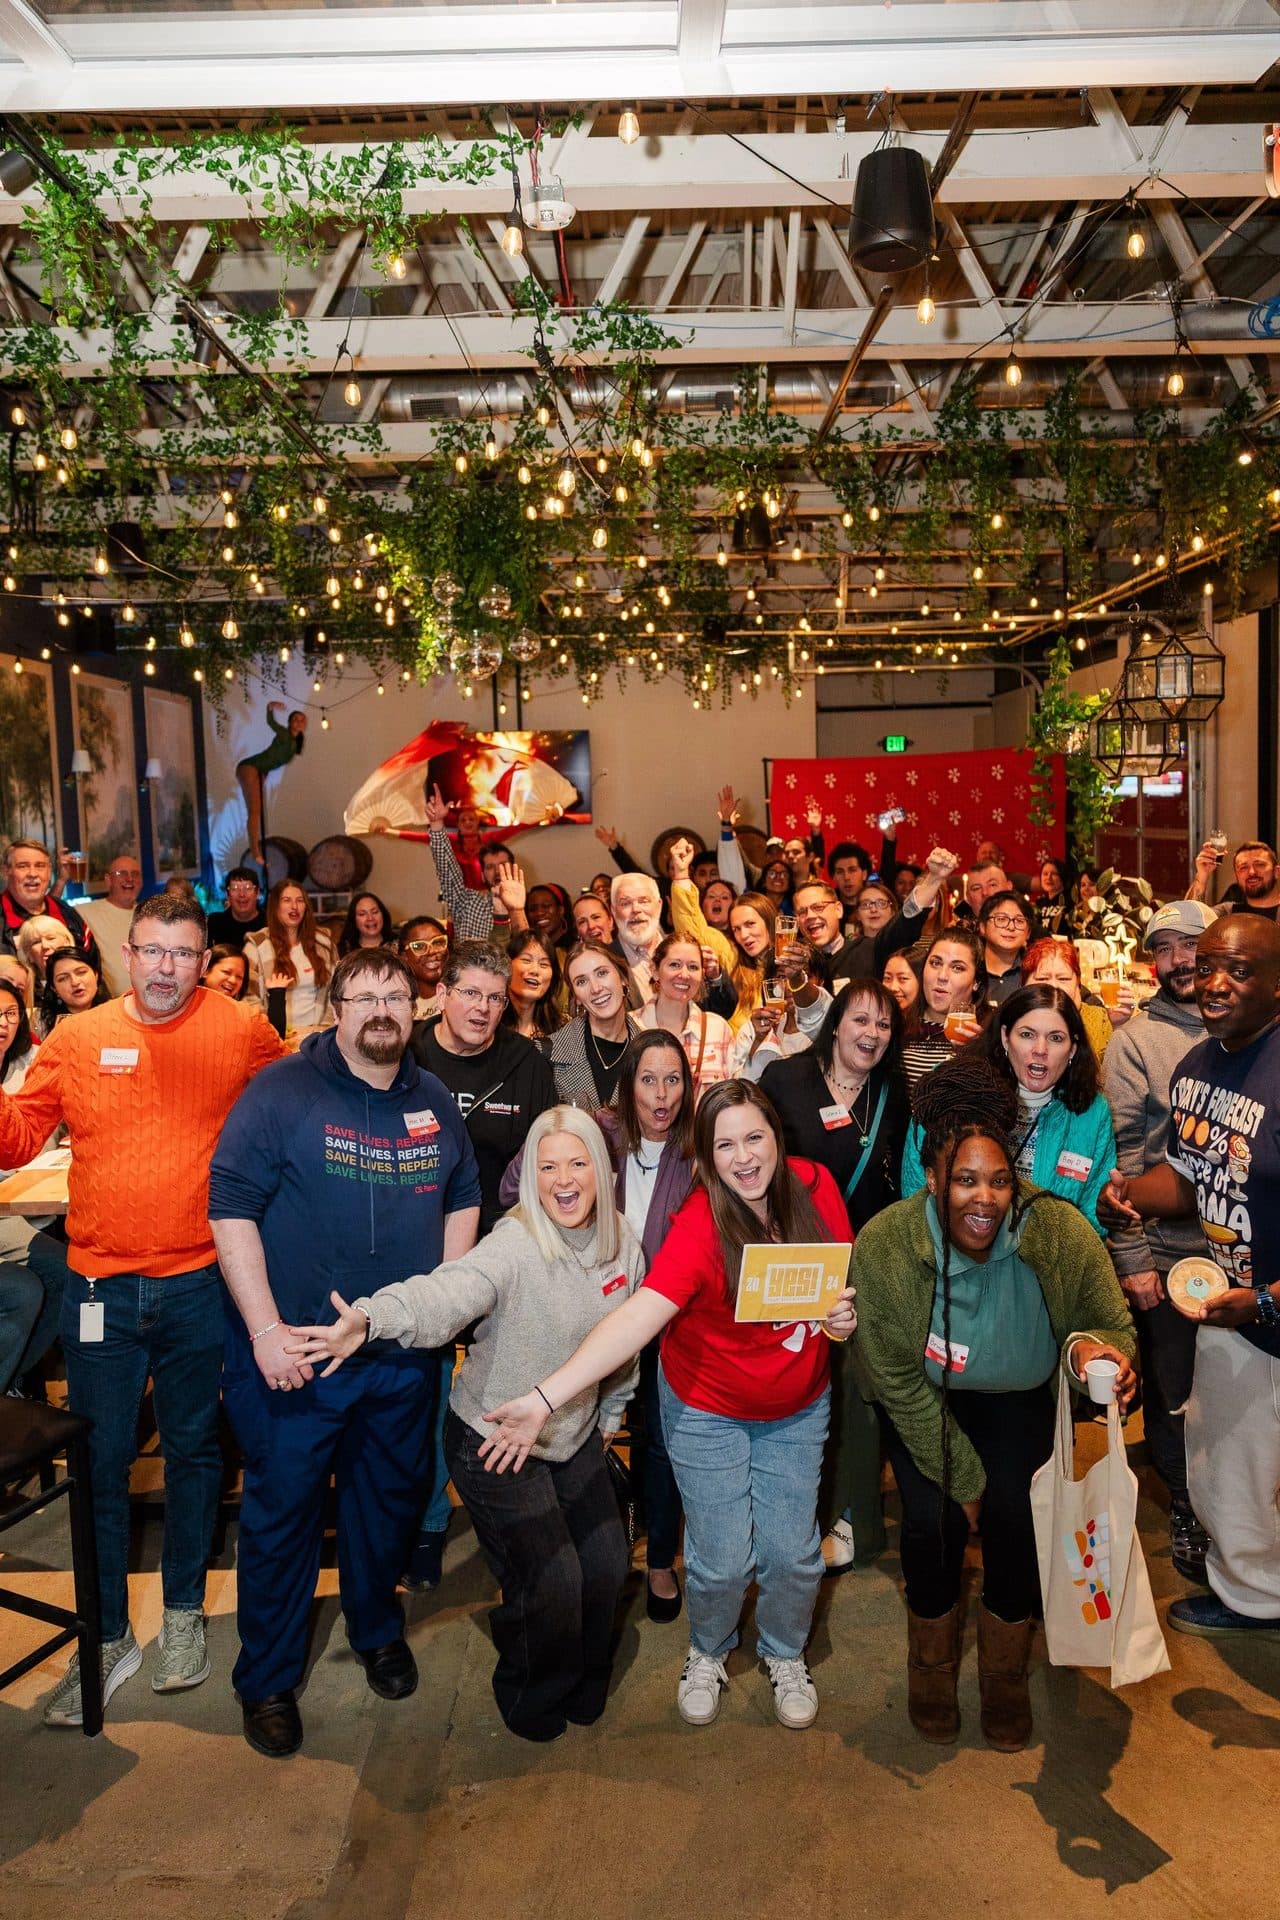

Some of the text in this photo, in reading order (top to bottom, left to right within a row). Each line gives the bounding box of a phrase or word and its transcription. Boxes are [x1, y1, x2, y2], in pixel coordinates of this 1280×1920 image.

[1204, 1086, 1266, 1139] FORECAST
[325, 1123, 438, 1148] SAVE LIVES. REPEAT.
[325, 1136, 440, 1161] SAVE LIVES. REPEAT.
[325, 1149, 440, 1173] SAVE LIVES. REPEAT.
[325, 1162, 439, 1185] SAVE LIVES. REPEAT.
[1213, 1164, 1231, 1195] of
[745, 1276, 760, 1292] 20
